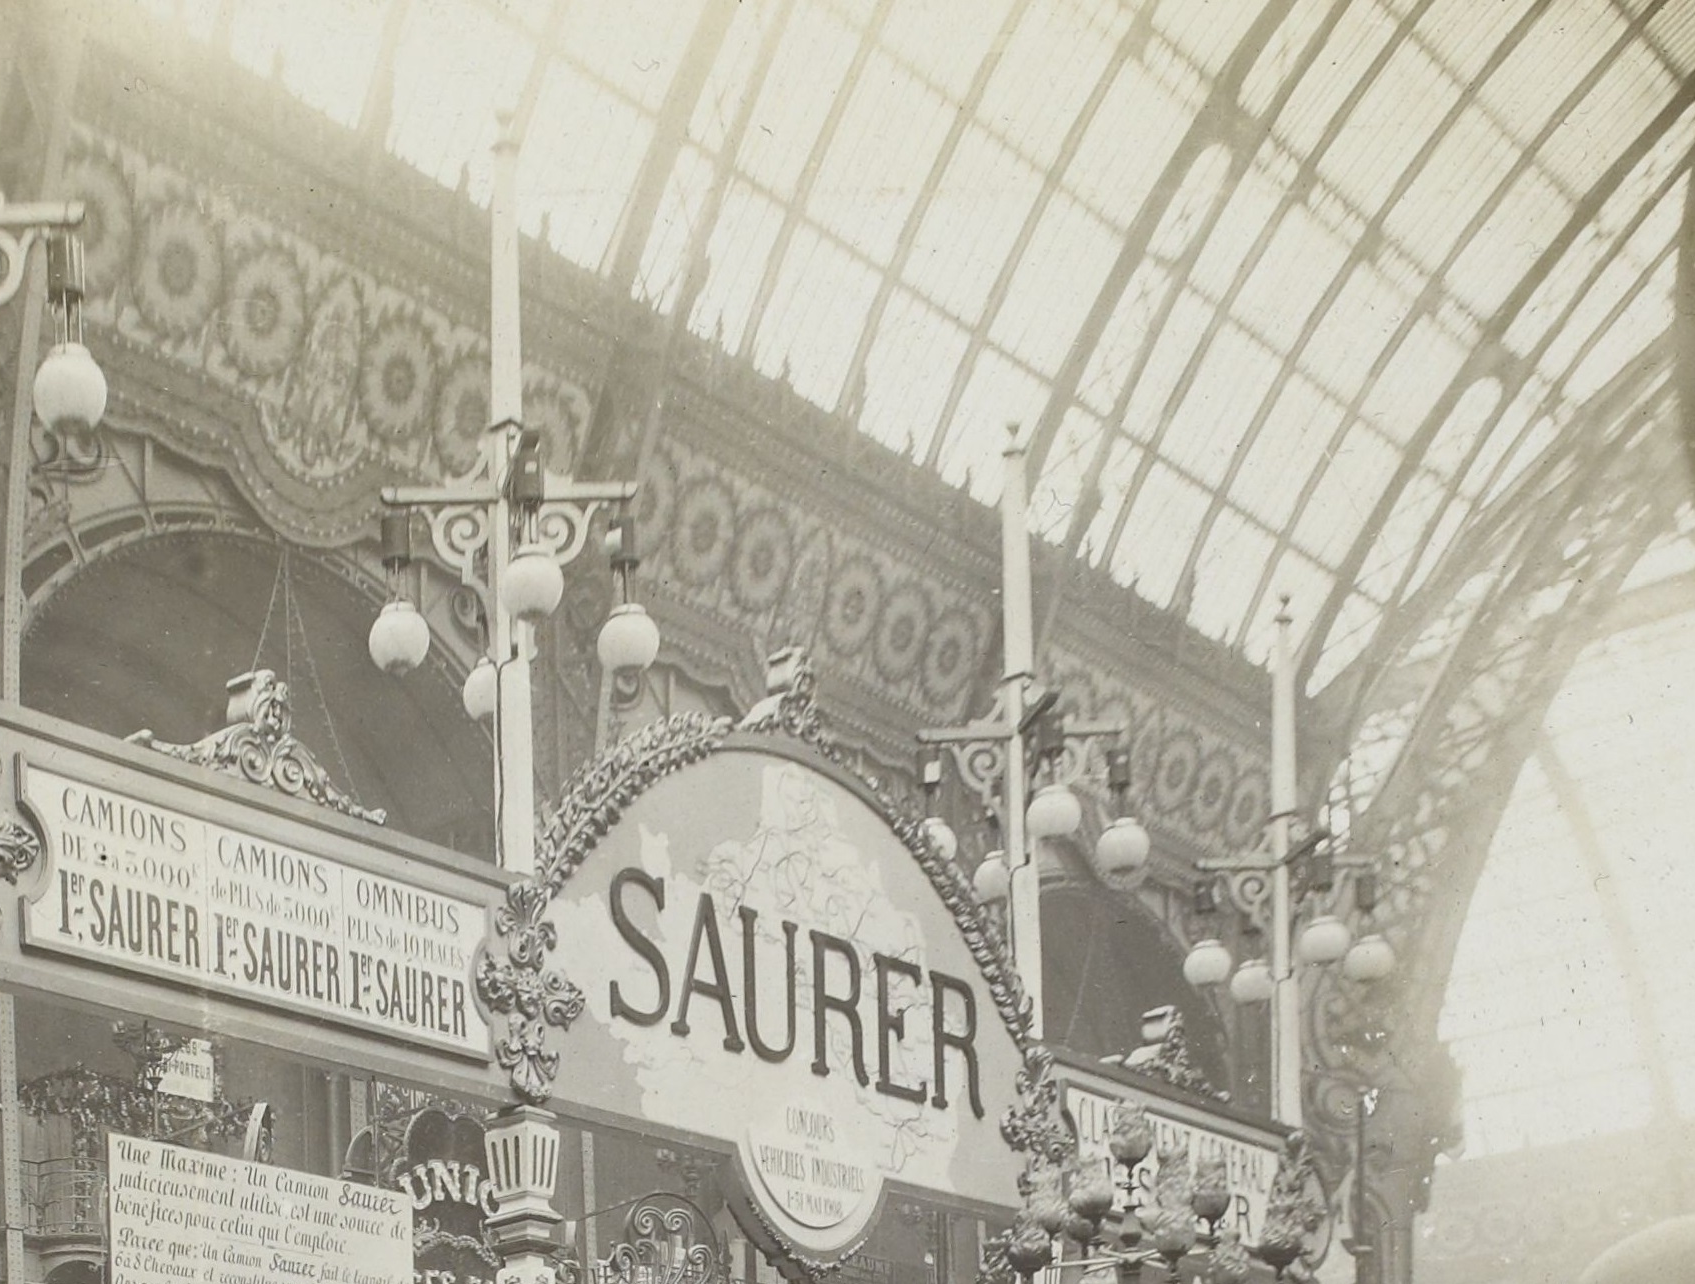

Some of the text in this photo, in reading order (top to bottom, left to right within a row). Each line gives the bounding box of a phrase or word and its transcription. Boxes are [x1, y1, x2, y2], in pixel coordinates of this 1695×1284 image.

[62, 787, 187, 853] CAMIONS
[62, 831, 88, 862] DE
[218, 835, 327, 895] CAMIONS
[89, 879, 200, 968] SAURER
[347, 915, 382, 948] PLUS
[357, 878, 459, 935] OMNIBUS
[243, 921, 340, 1004] SAURER
[376, 959, 466, 1038] SAURER
[609, 867, 985, 1120] SAURER
[786, 1105, 835, 1143] CONCOURS
[117, 1140, 151, 1164] Une
[245, 1165, 267, 1187] Un
[276, 1172, 329, 1200] Camion
[339, 1184, 402, 1214] Saurer
[811, 1156, 865, 1193] INDUSTRIELS
[113, 1171, 405, 1240] judicieusement est une source de
[185, 1213, 216, 1230] pour
[220, 1214, 253, 1236] celui
[258, 1225, 279, 1245] qui
[118, 1227, 164, 1250] Parce
[200, 1242, 217, 1261] Un
[223, 1244, 262, 1268] Camion
[269, 1253, 316, 1277] Saurer
[317, 1265, 338, 1283] fait
[143, 1253, 196, 1279] Chevaux
[203, 1265, 214, 1283] et
